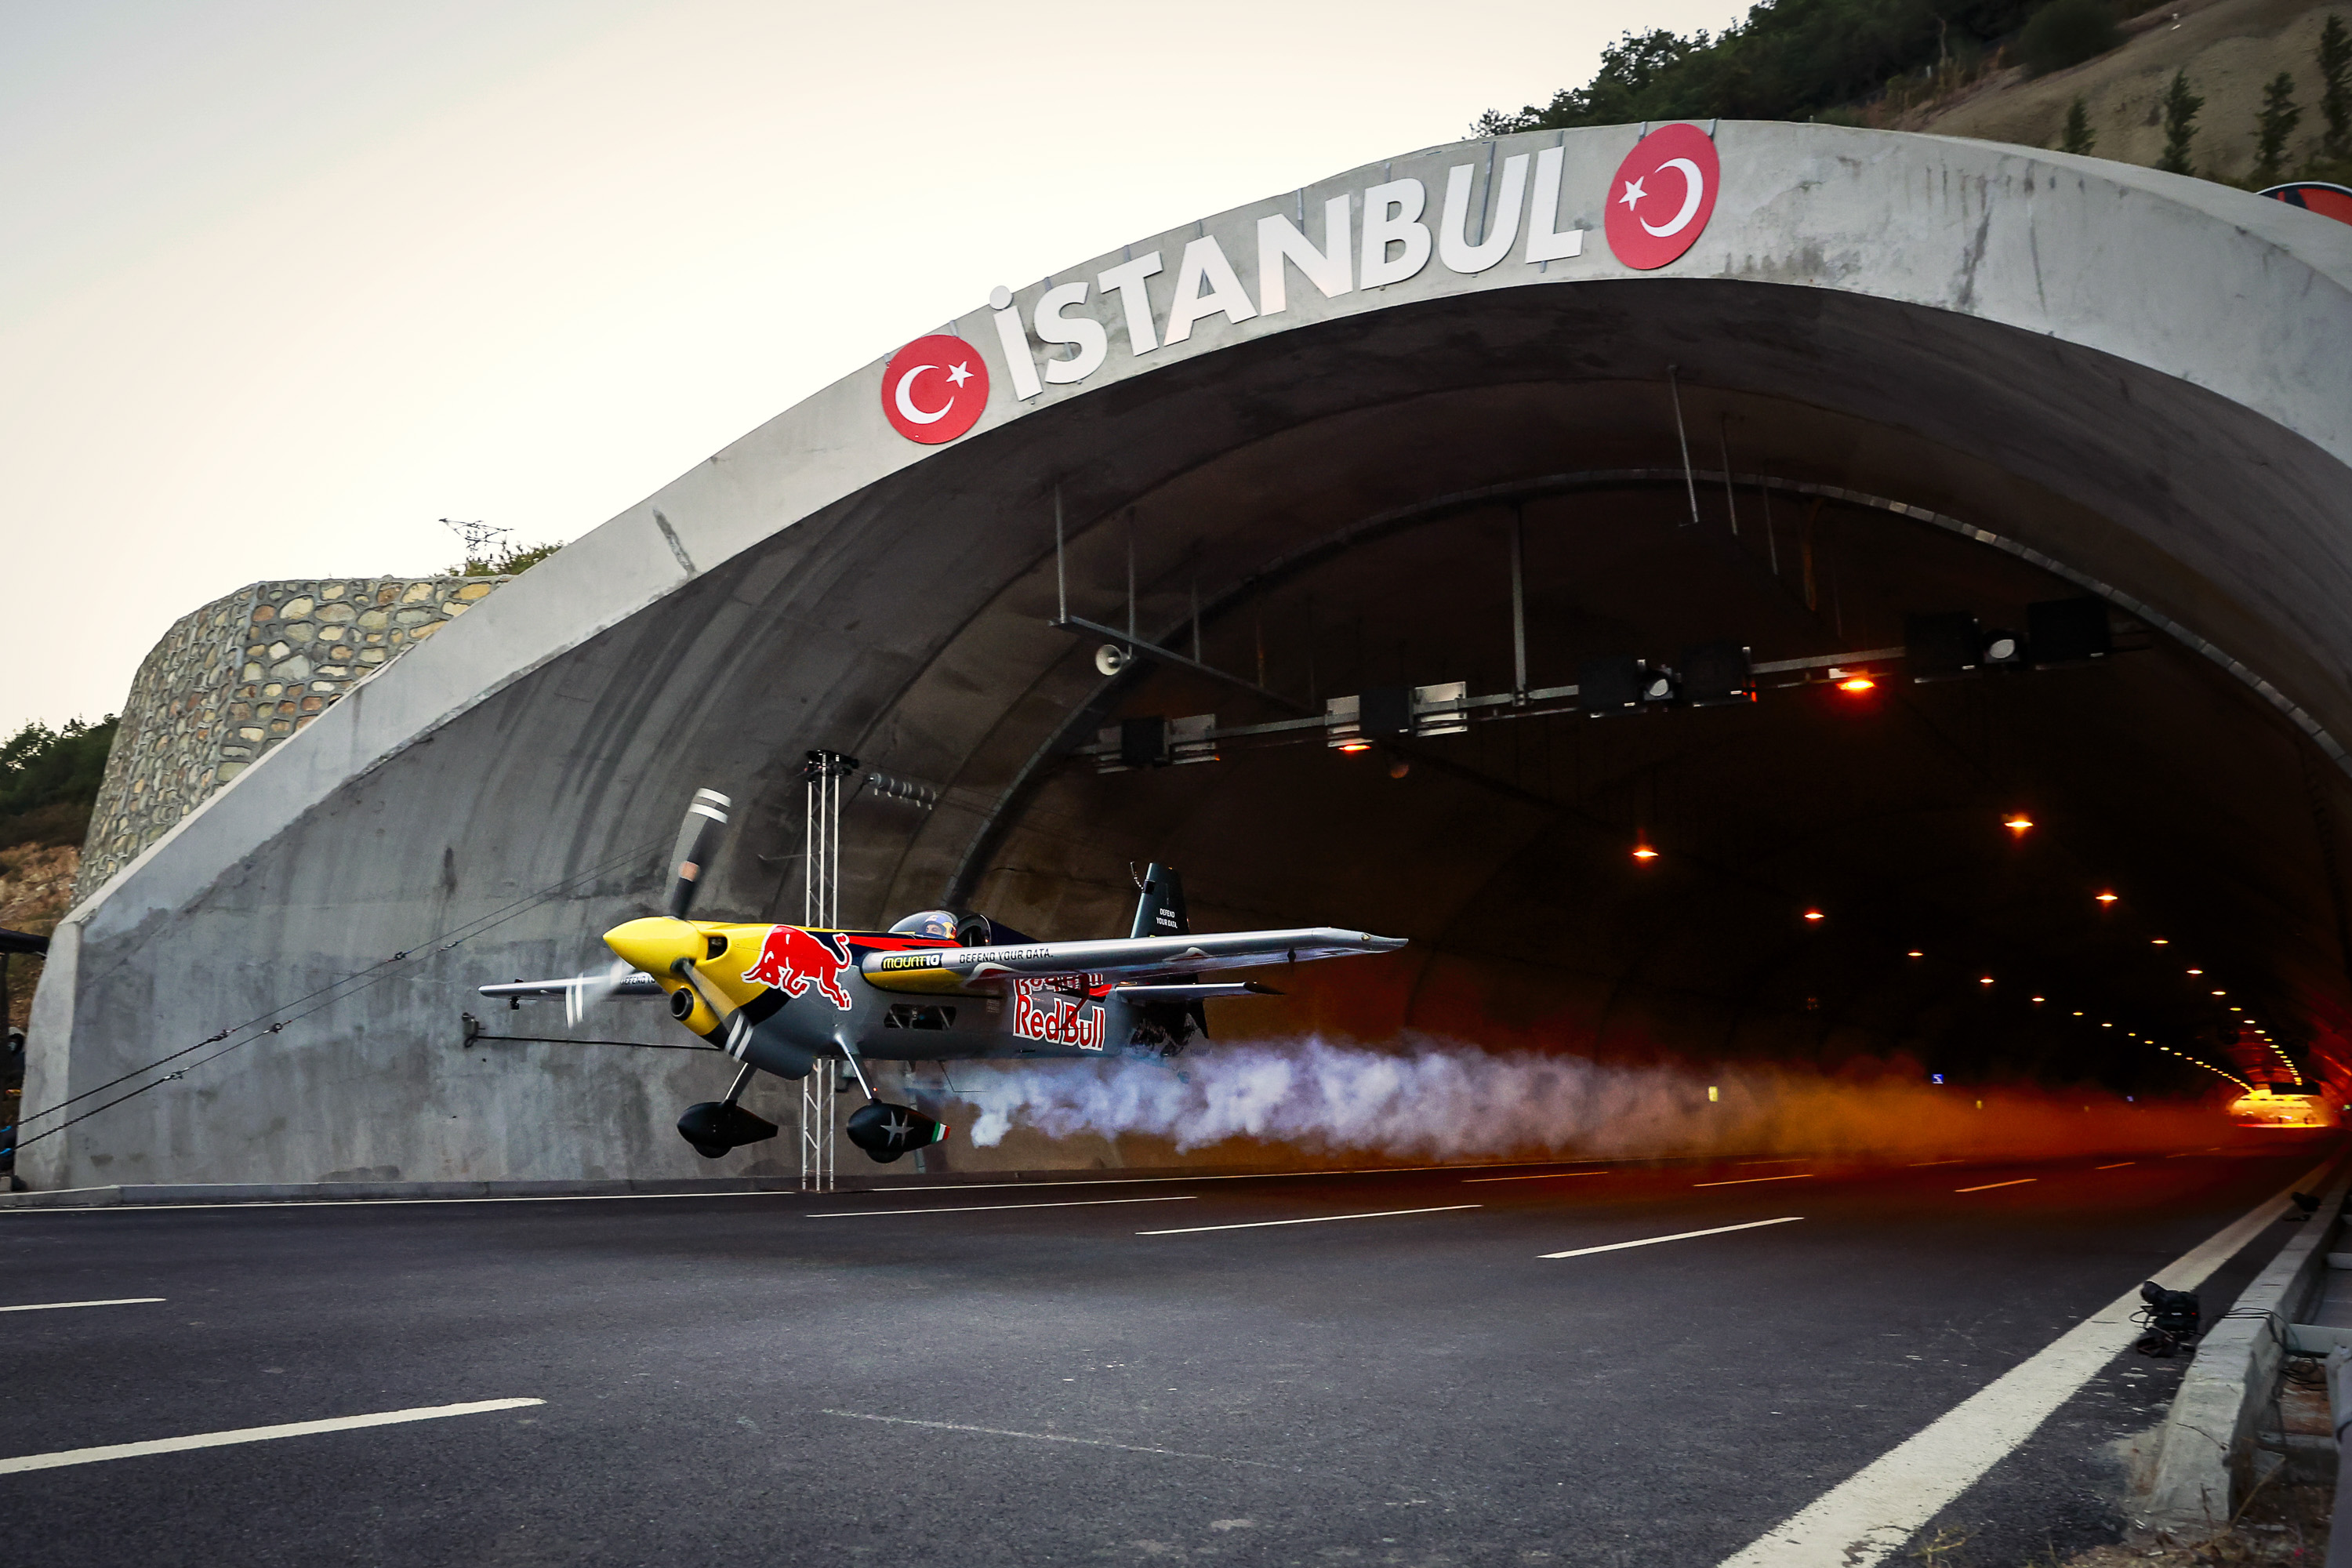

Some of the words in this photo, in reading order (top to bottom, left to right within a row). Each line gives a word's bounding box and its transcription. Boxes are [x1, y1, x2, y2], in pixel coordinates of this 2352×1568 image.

[989, 147, 1583, 401] İSTANBUL
[1156, 916, 1167, 926] YOUR
[1160, 908, 1175, 918] DEFEND
[960, 952, 996, 964] DEFEND
[998, 949, 1024, 961] YOUR
[1025, 948, 1054, 960] DATA.
[1013, 994, 1062, 1044] Red
[1061, 1002, 1105, 1051] Bull
